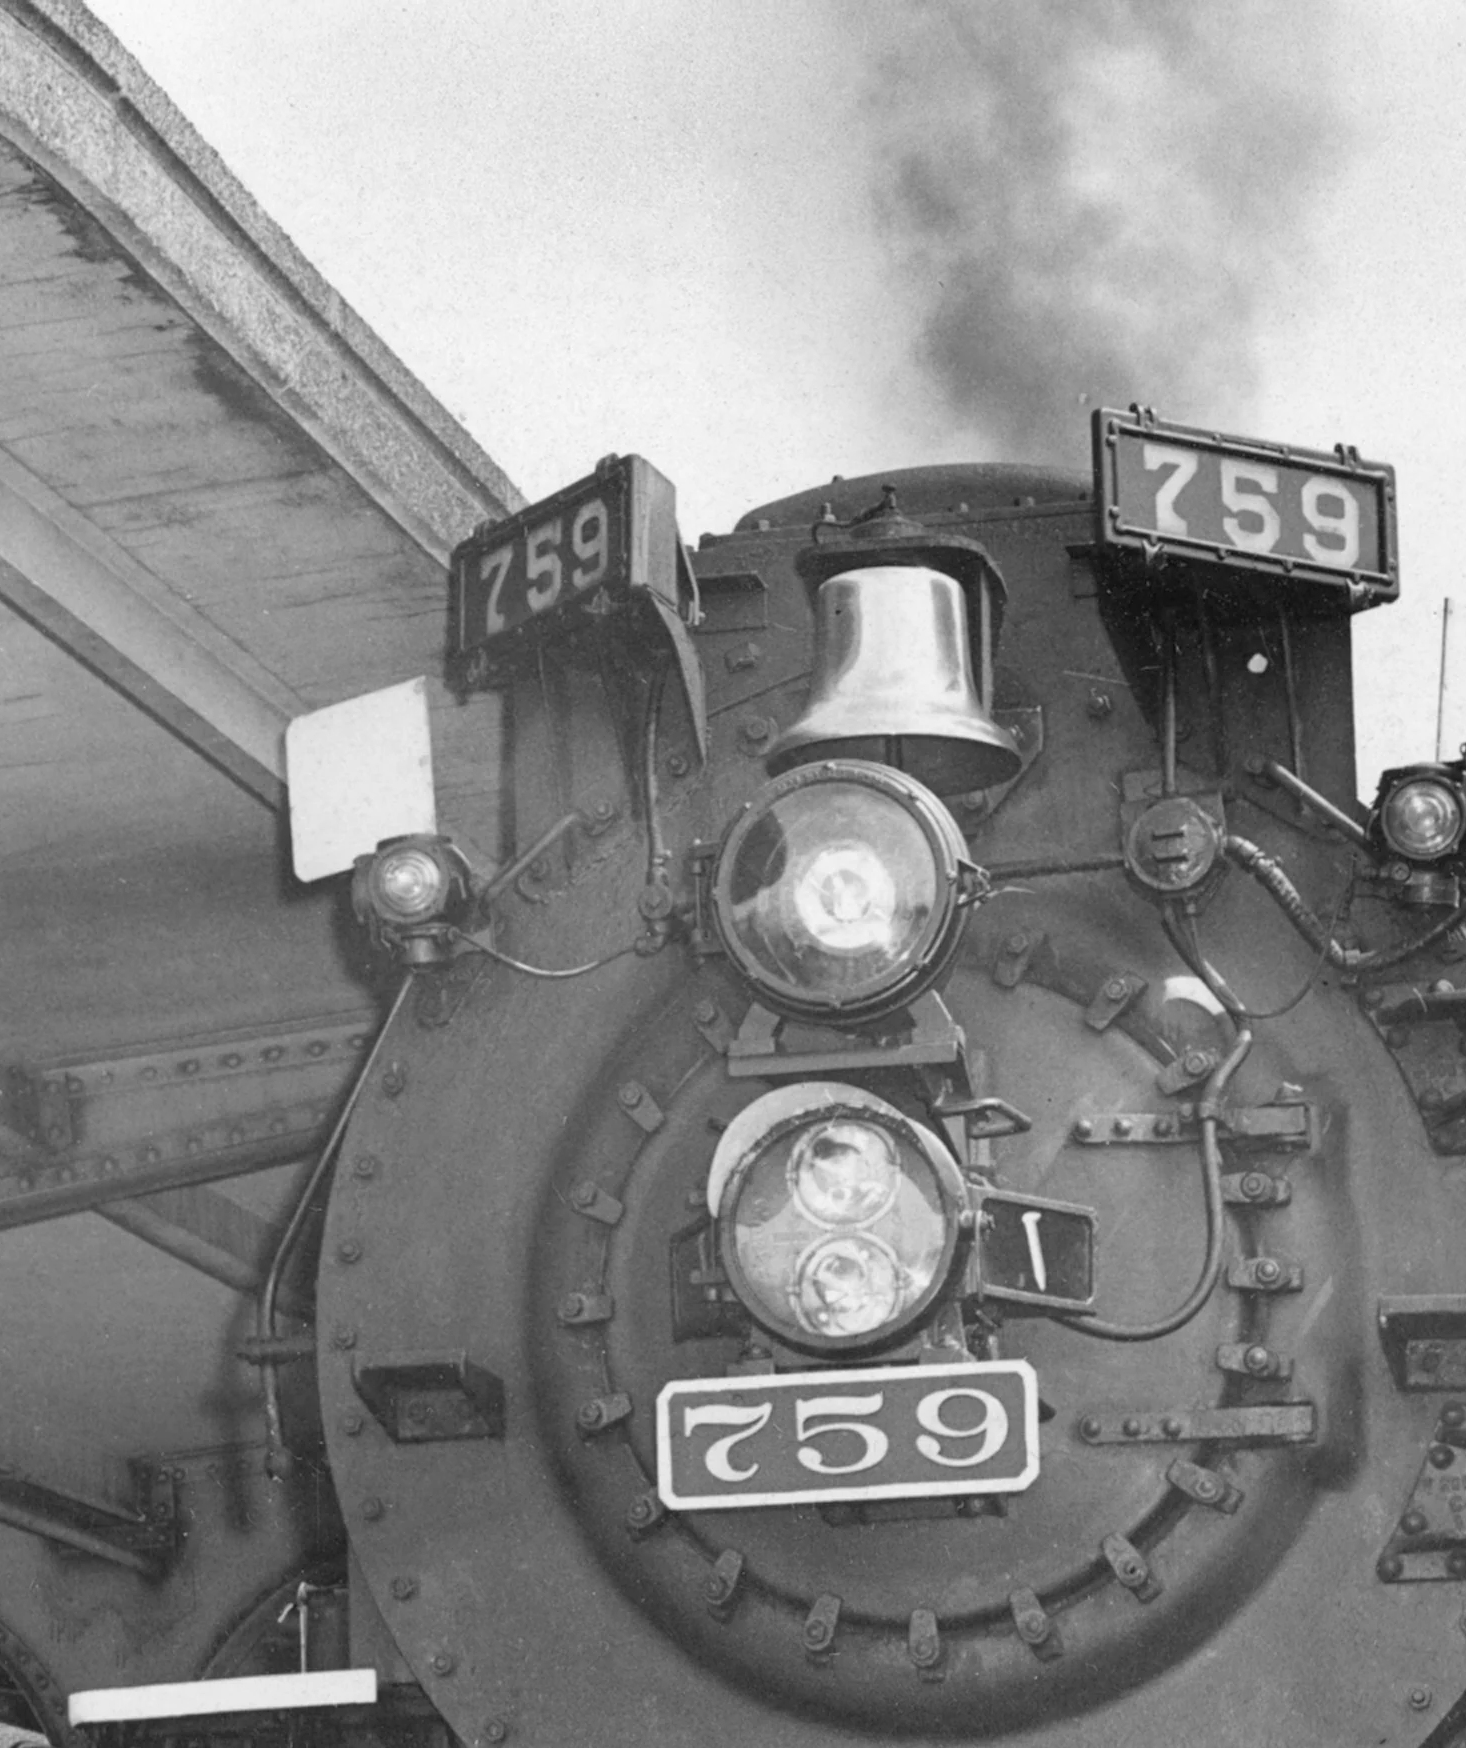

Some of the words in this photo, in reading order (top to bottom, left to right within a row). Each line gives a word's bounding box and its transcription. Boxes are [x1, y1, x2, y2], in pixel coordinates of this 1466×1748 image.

[479, 498, 609, 632] 759
[1143, 445, 1362, 572] 759
[683, 1387, 1009, 1482] 759
